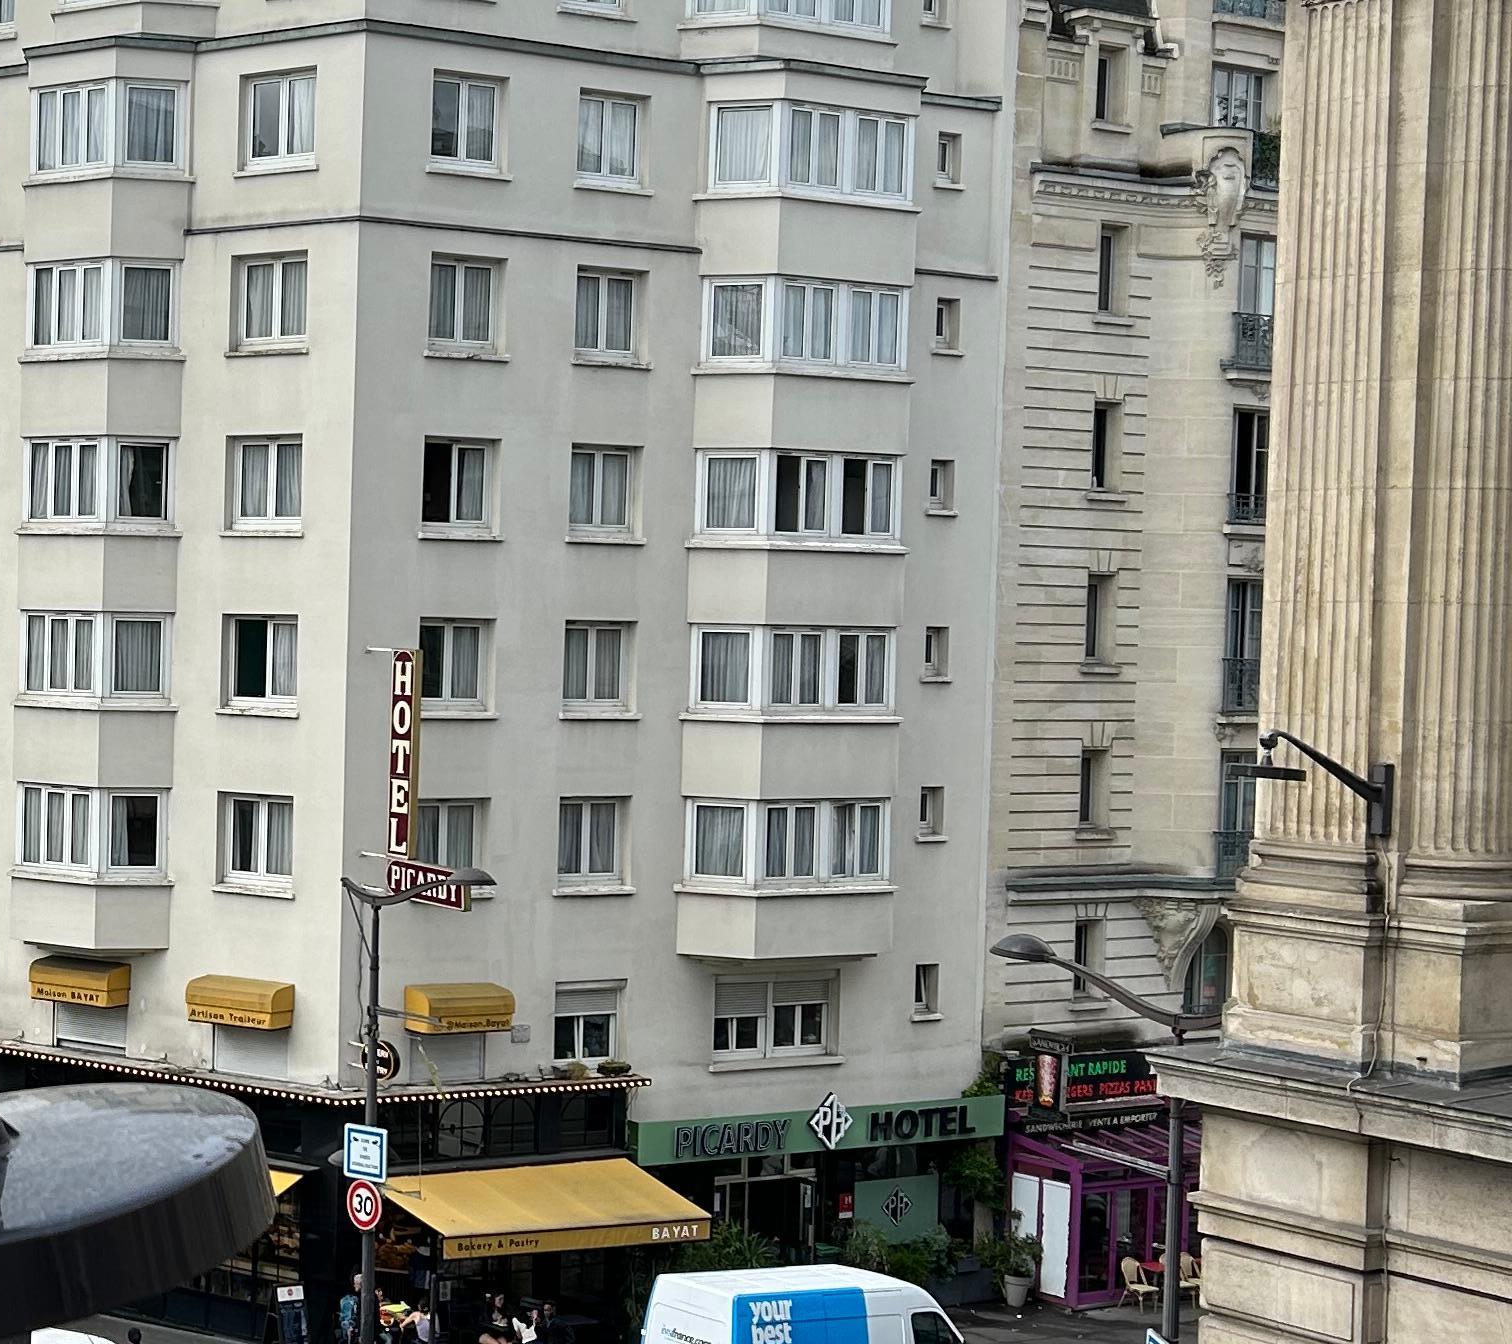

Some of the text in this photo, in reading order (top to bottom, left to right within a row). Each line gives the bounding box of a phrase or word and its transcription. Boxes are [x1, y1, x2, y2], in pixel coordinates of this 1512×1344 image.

[389, 661, 412, 854] HOTEL
[70, 990, 100, 1003] BAYAT
[190, 1007, 267, 1026] Artisan Traiteur
[1088, 1059, 1127, 1076] RAPIDE
[675, 1118, 792, 1159] PICARDY
[869, 1105, 976, 1142] HOTEL
[354, 1193, 373, 1217] 30
[651, 1224, 699, 1240] BAYAT
[457, 1237, 540, 1252] Bakery & Pastry
[749, 1298, 793, 1323] your
